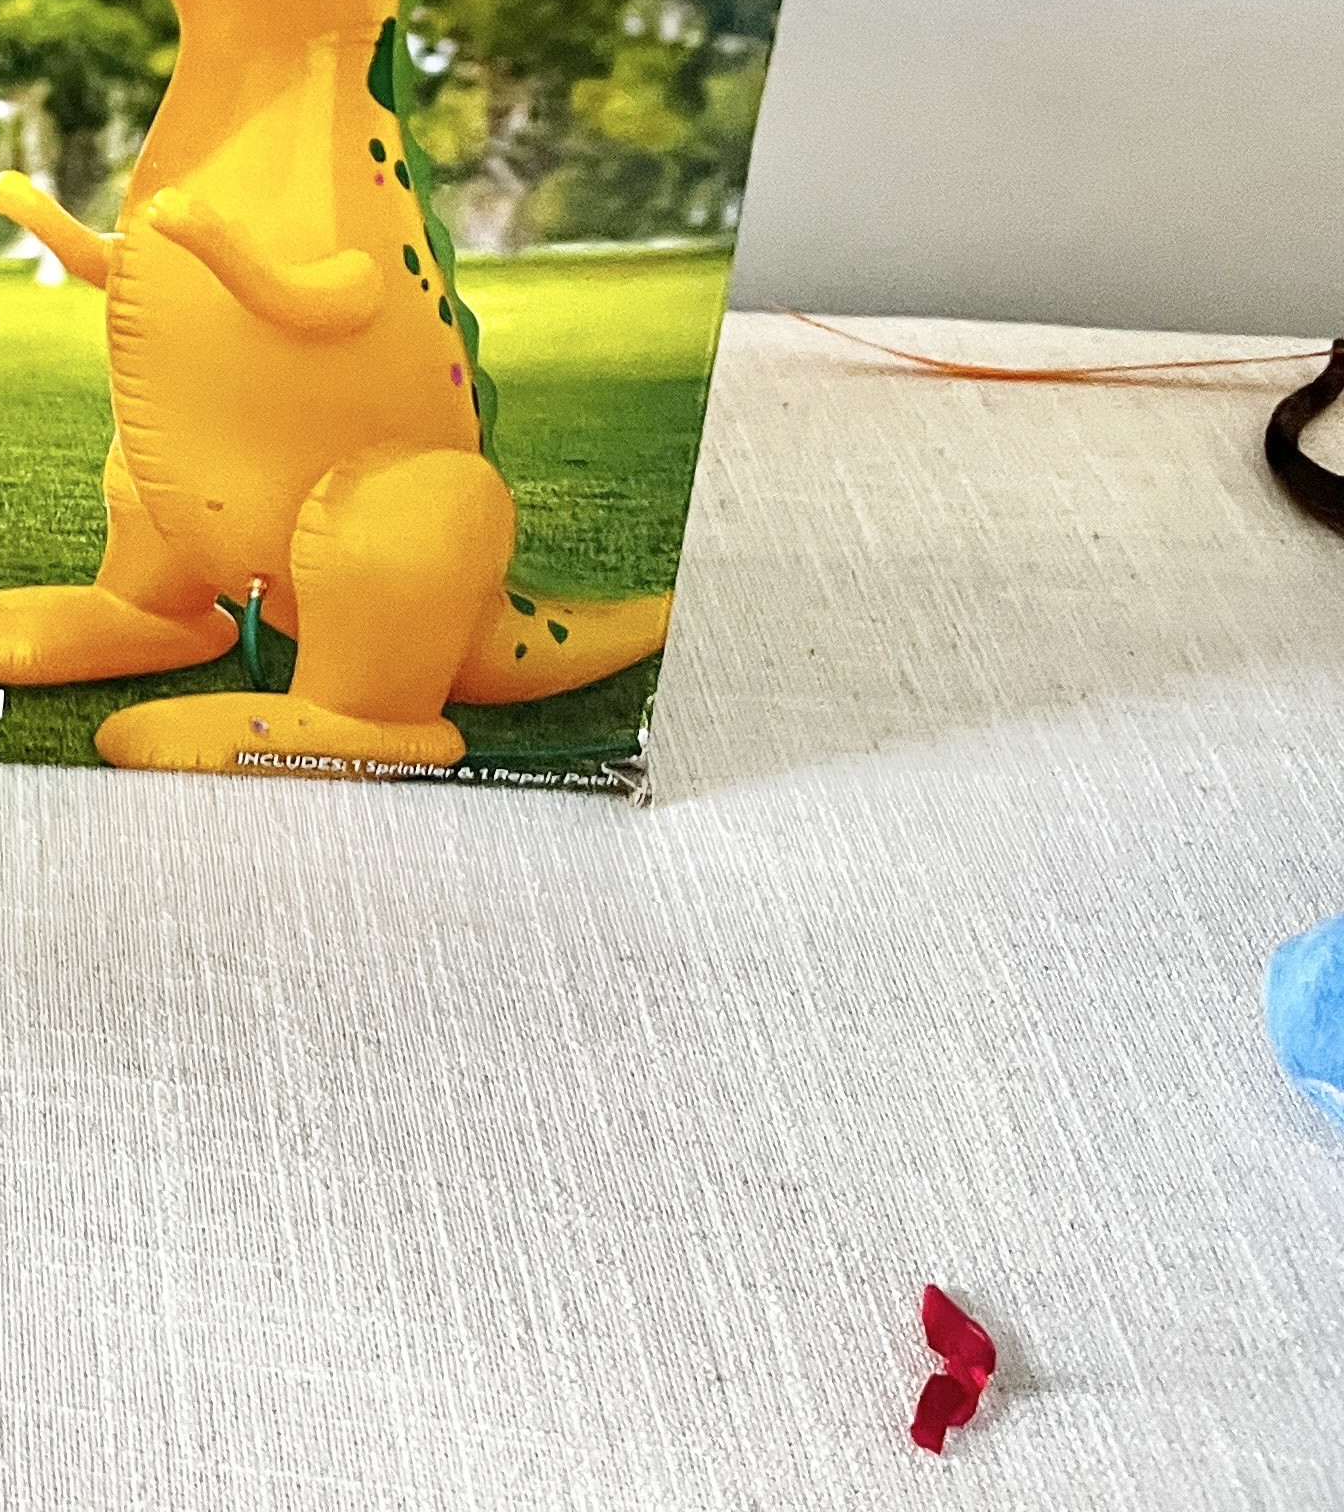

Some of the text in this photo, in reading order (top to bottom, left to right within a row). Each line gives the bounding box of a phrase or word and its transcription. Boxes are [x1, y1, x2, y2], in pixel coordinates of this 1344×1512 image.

[237, 751, 347, 773] INCLUDES:
[351, 759, 363, 773] 1
[365, 759, 455, 779] Sprinkler
[493, 767, 561, 785] Repair
[563, 772, 619, 787] Patch
